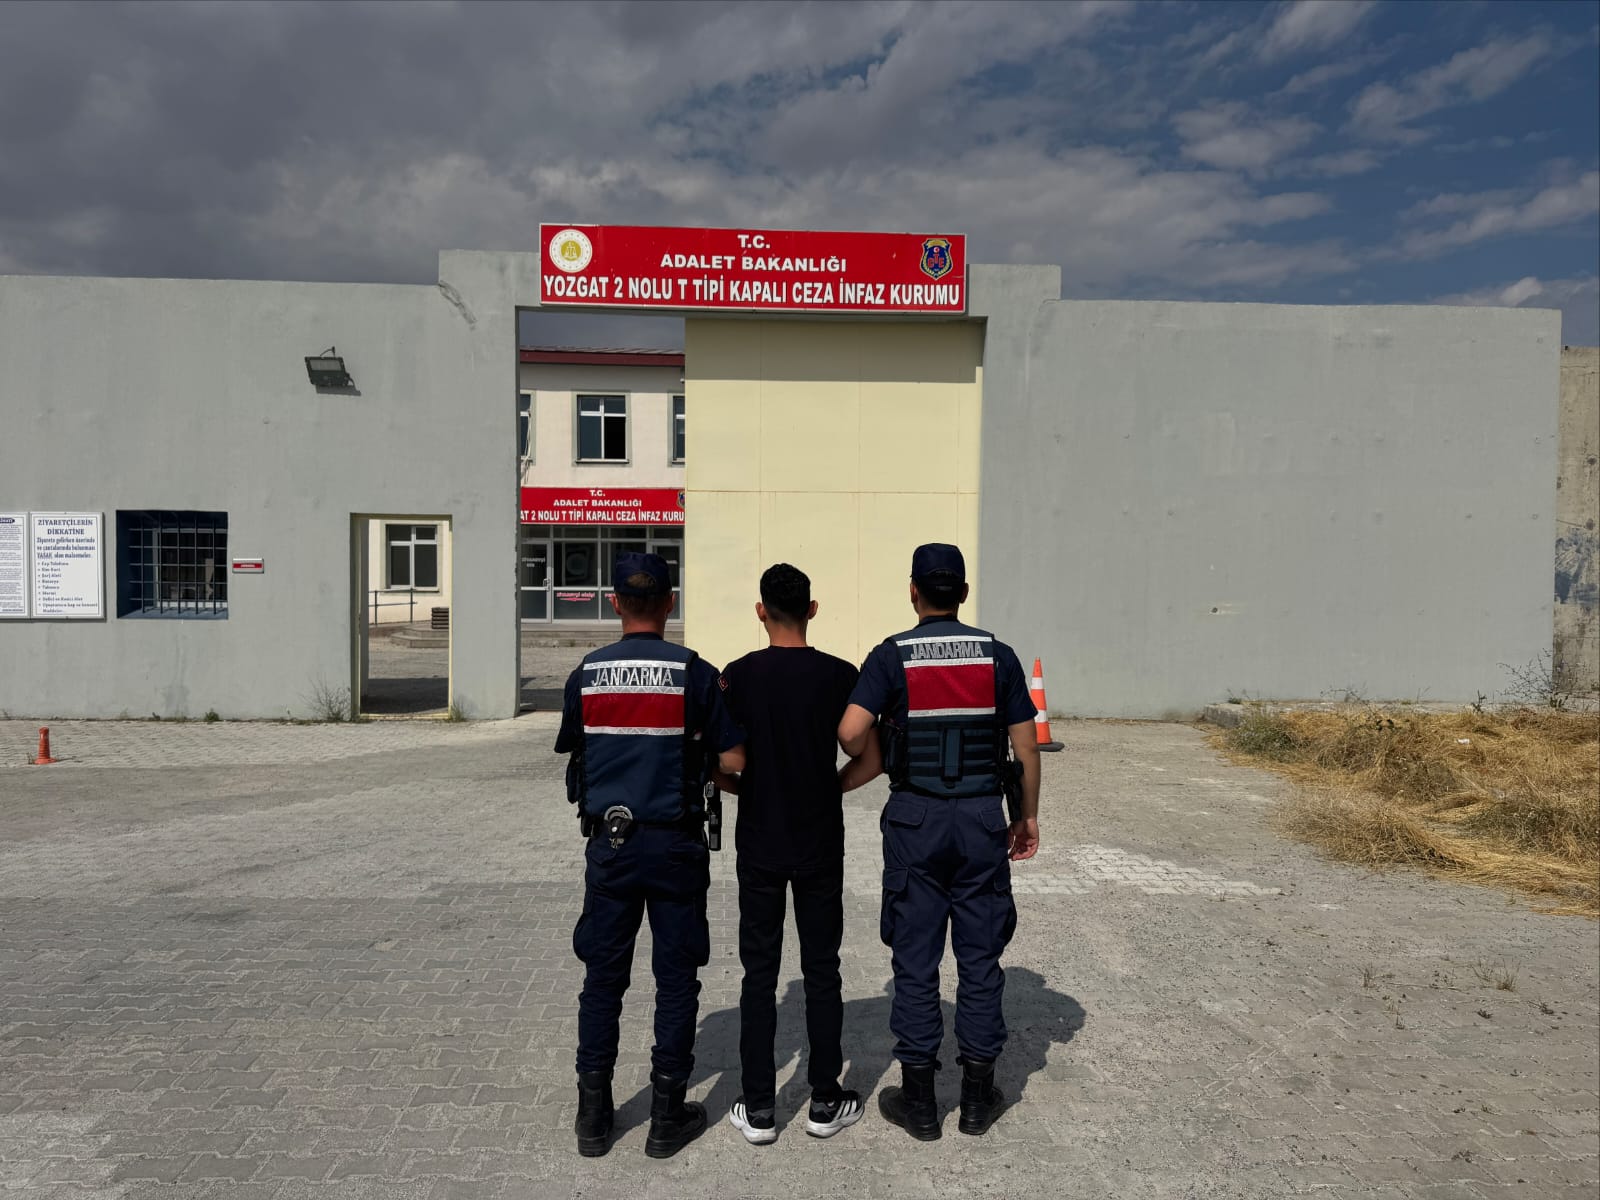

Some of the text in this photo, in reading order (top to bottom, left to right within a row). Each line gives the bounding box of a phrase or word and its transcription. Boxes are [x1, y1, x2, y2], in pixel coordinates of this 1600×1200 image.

[737, 234, 770, 249] T.C.
[660, 254, 846, 272] ADALET BAKANLIĞI
[544, 274, 960, 306] YOZGAT 2 NOLU T TİPİ KAPALI CEZA İNFAZ KURUMU
[592, 498, 642, 507] BAKANLIĞI
[38, 518, 93, 527] ZİYARETÇİLERİN
[531, 510, 536, 520] 2
[538, 510, 559, 520] NOLU
[562, 510, 567, 521] T
[569, 509, 584, 521] TİPİ
[586, 510, 614, 521] KAPALI
[616, 511, 636, 521] CEZA
[638, 509, 660, 522] İNFAZ
[911, 642, 984, 660] JANDARMA
[591, 667, 674, 686] JANDARMA
